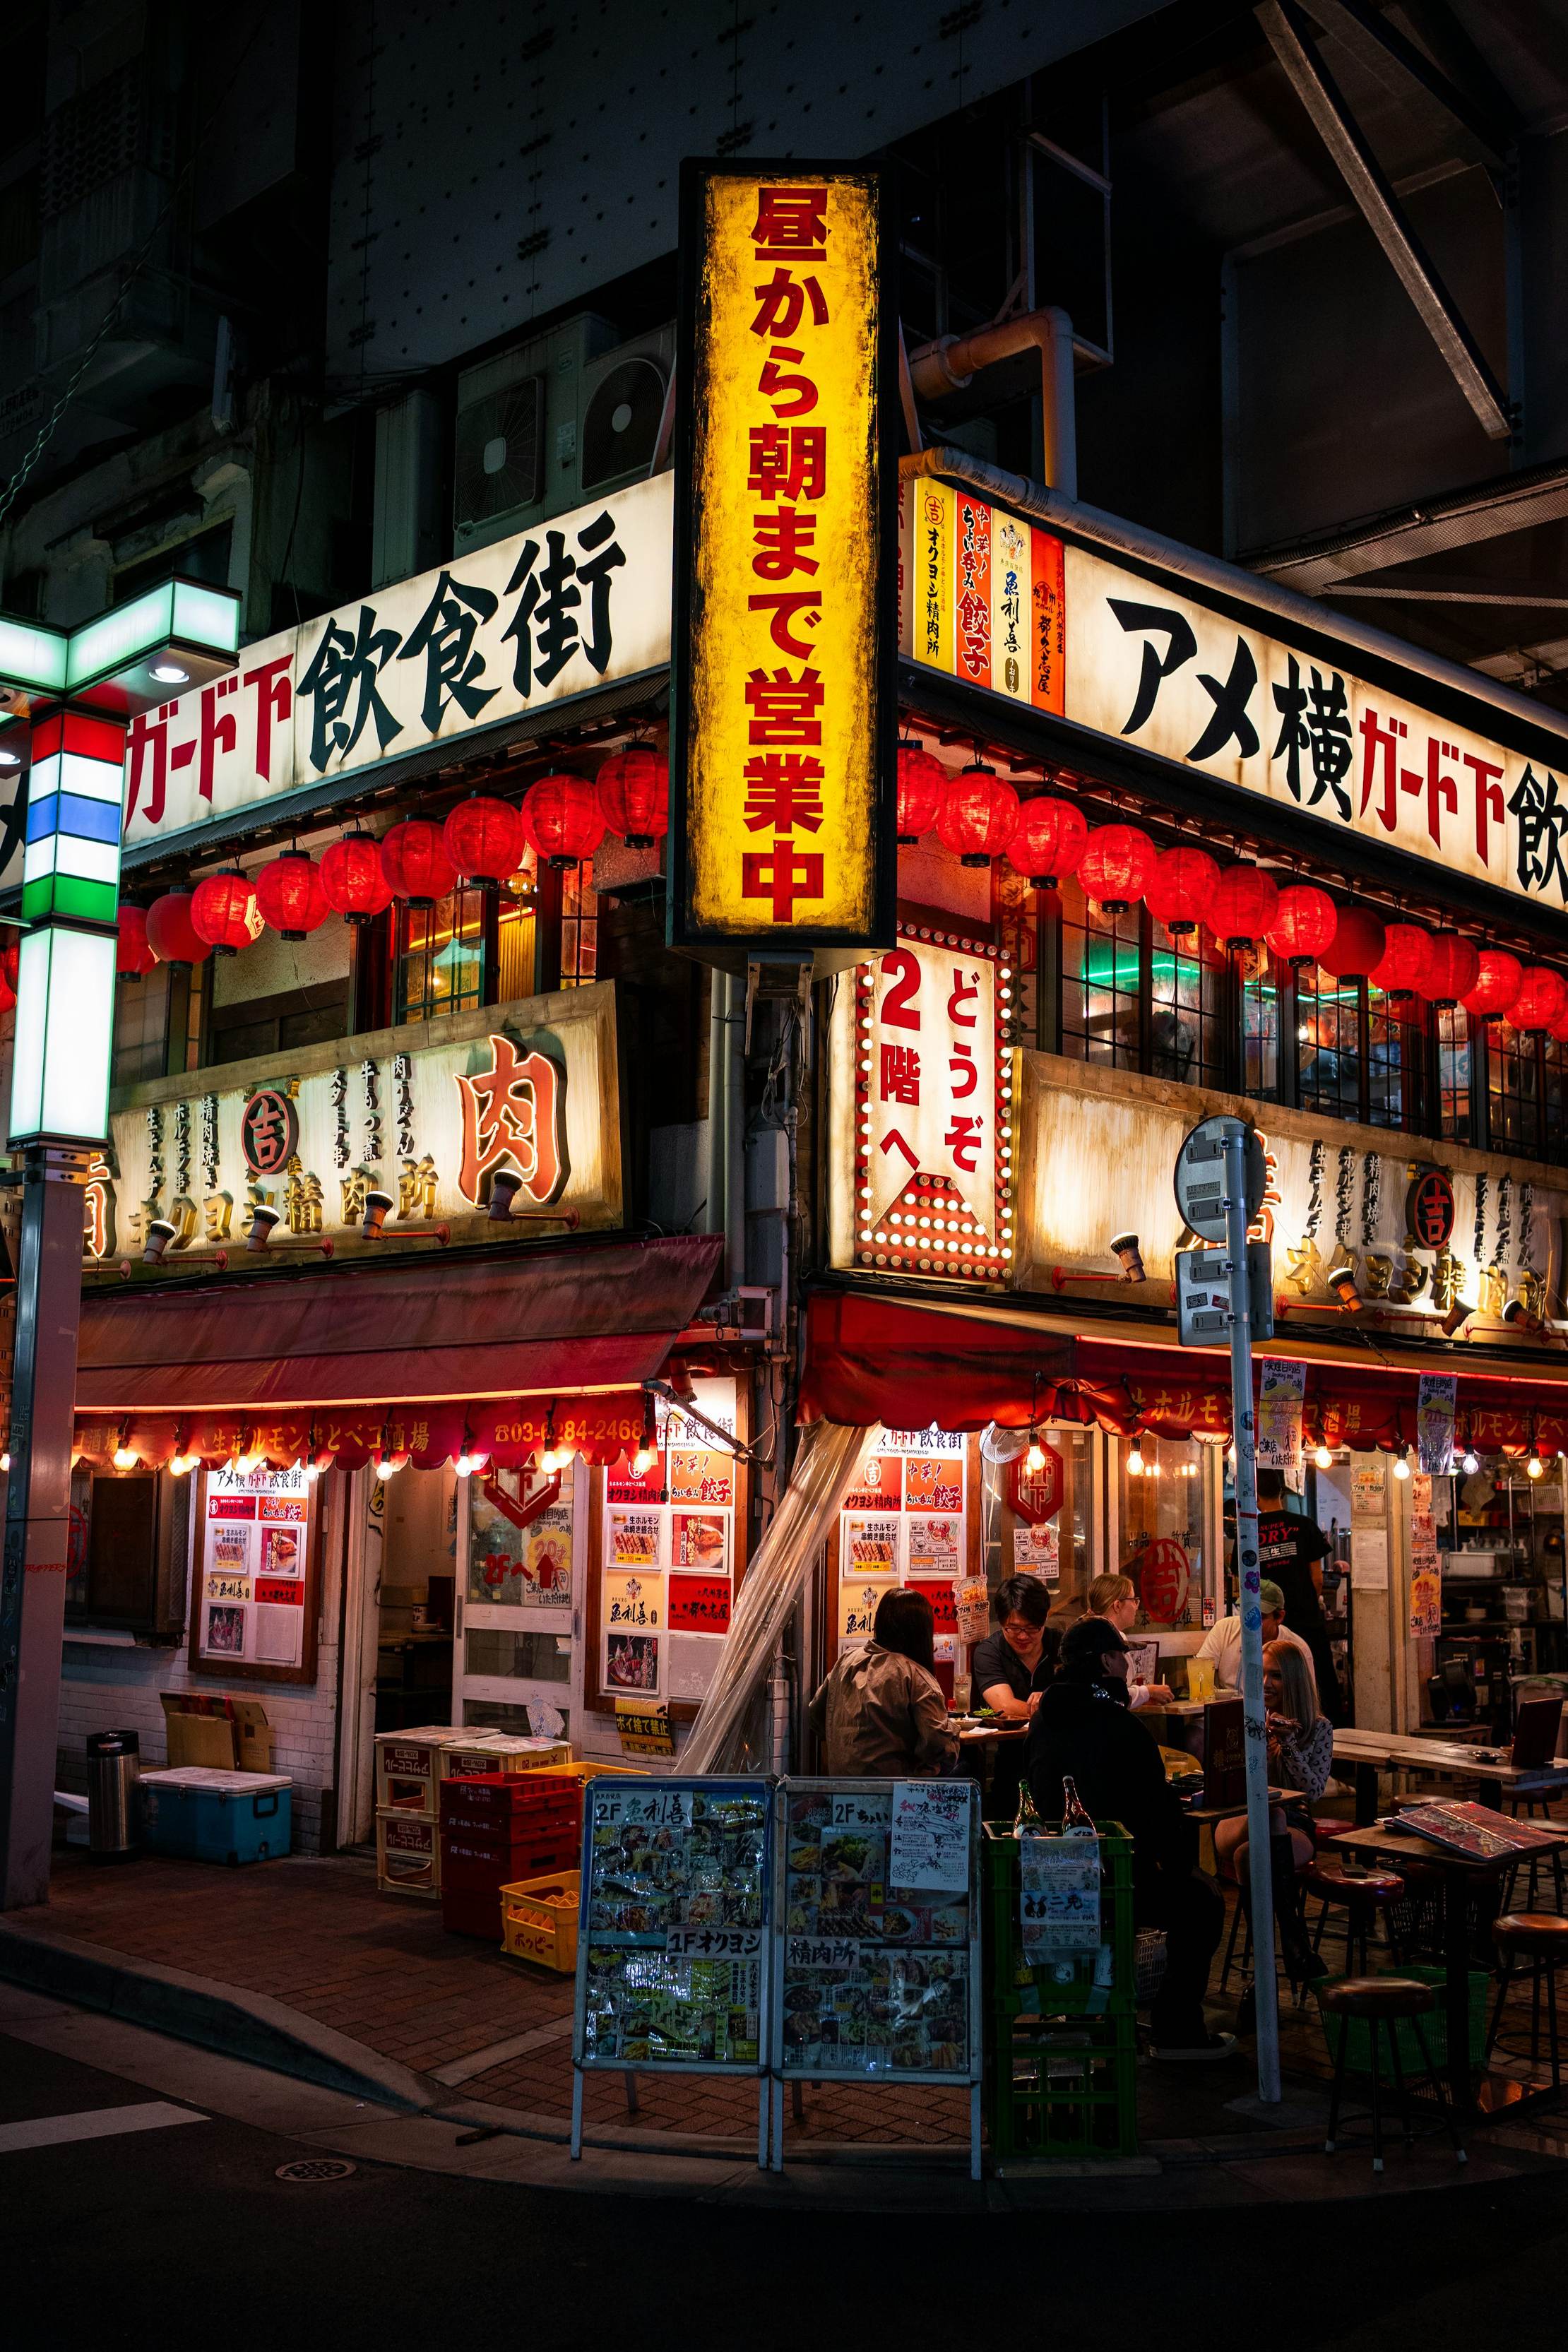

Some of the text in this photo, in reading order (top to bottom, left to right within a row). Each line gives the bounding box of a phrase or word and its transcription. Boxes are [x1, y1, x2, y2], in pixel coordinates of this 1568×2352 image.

[742, 187, 832, 923] 昼から朝まで営業中
[961, 504, 977, 590] ちょい呑み
[927, 527, 940, 660] オクヨシ精肉所
[957, 590, 991, 678] 餃子
[1037, 613, 1051, 695] 都久志屋
[879, 946, 922, 1172] 2階へ
[944, 967, 985, 1173] どうぞ
[247, 1097, 282, 1168] 吉
[330, 1068, 350, 1168] スタミナ串
[361, 1059, 379, 1163] 牛もつ煮
[393, 1054, 412, 1156] 肉うどん
[453, 1034, 560, 1206] 肉
[174, 1103, 190, 1194] ホルモン串
[1423, 1179, 1450, 1244] 吉
[918, 1428, 963, 1449] 飲食街
[623, 1526, 660, 1534] 串焼き盛合せ
[629, 1516, 660, 1525] 生ホルモン
[861, 1532, 897, 1541] 串焼き盛合せ
[867, 1523, 897, 1532] 生ホルモン
[1259, 1521, 1285, 1531] SUPER
[617, 1715, 670, 1736] ポイ捨て禁止
[384, 1758, 429, 1776] アサヒビール
[595, 1802, 622, 1822] 2F
[513, 1932, 555, 1954] ホッピー
[786, 1937, 857, 1966] 精肉所
